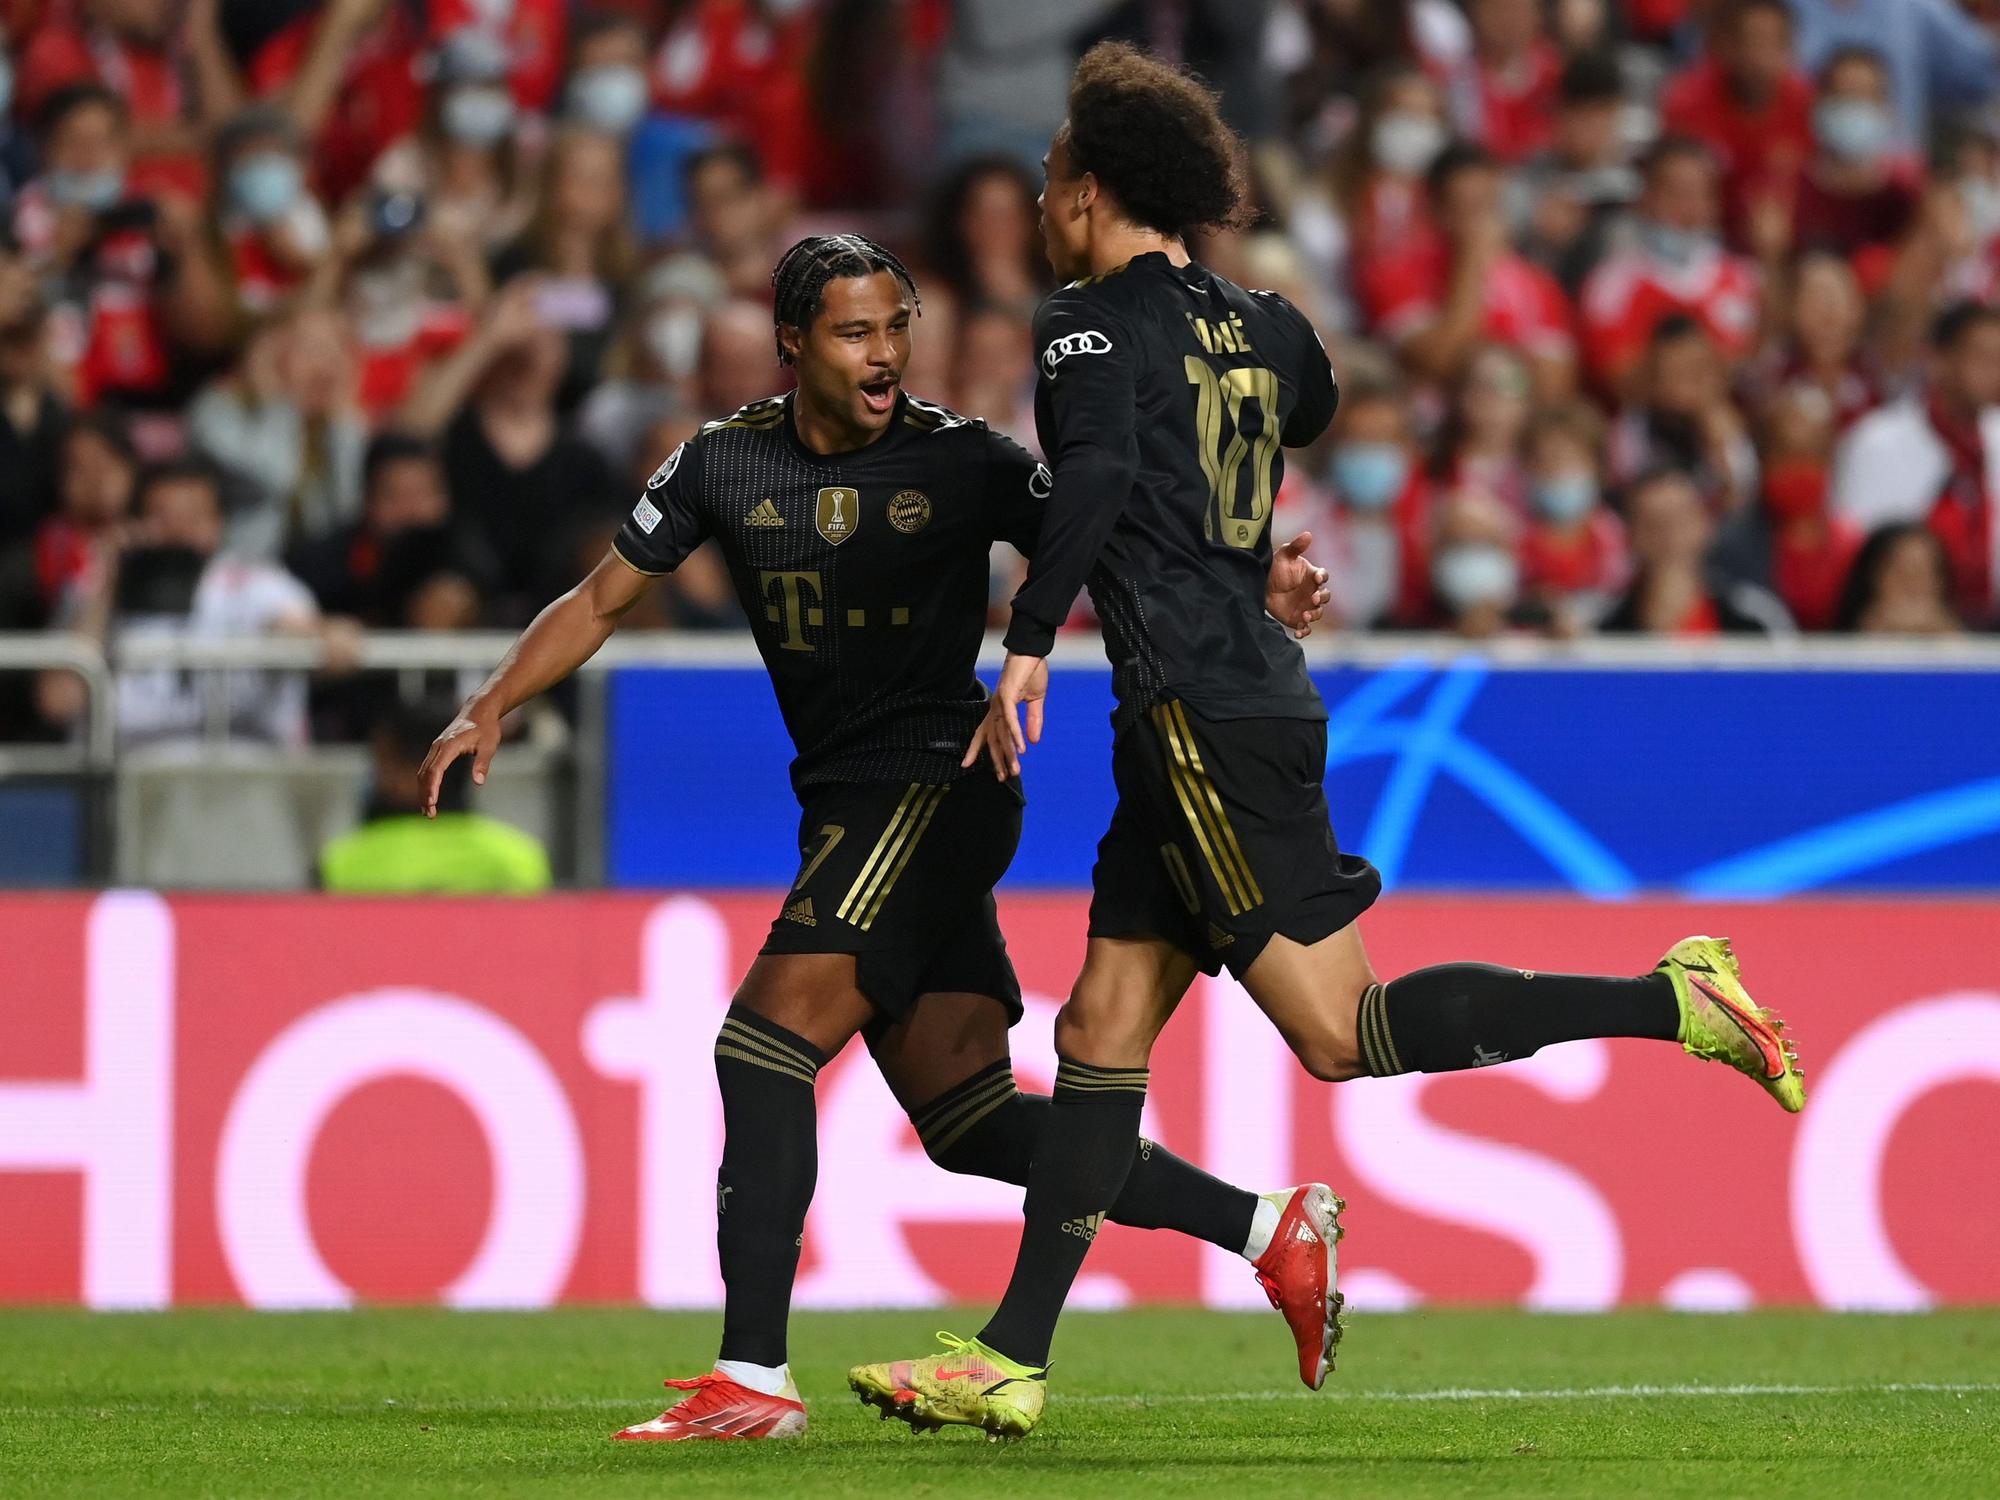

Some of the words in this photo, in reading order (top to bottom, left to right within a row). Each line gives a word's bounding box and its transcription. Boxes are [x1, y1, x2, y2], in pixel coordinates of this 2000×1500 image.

[1184, 355, 1280, 549] 10
[743, 514, 785, 526] adidas
[827, 523, 847, 531] FIFA
[795, 824, 845, 890] 7
